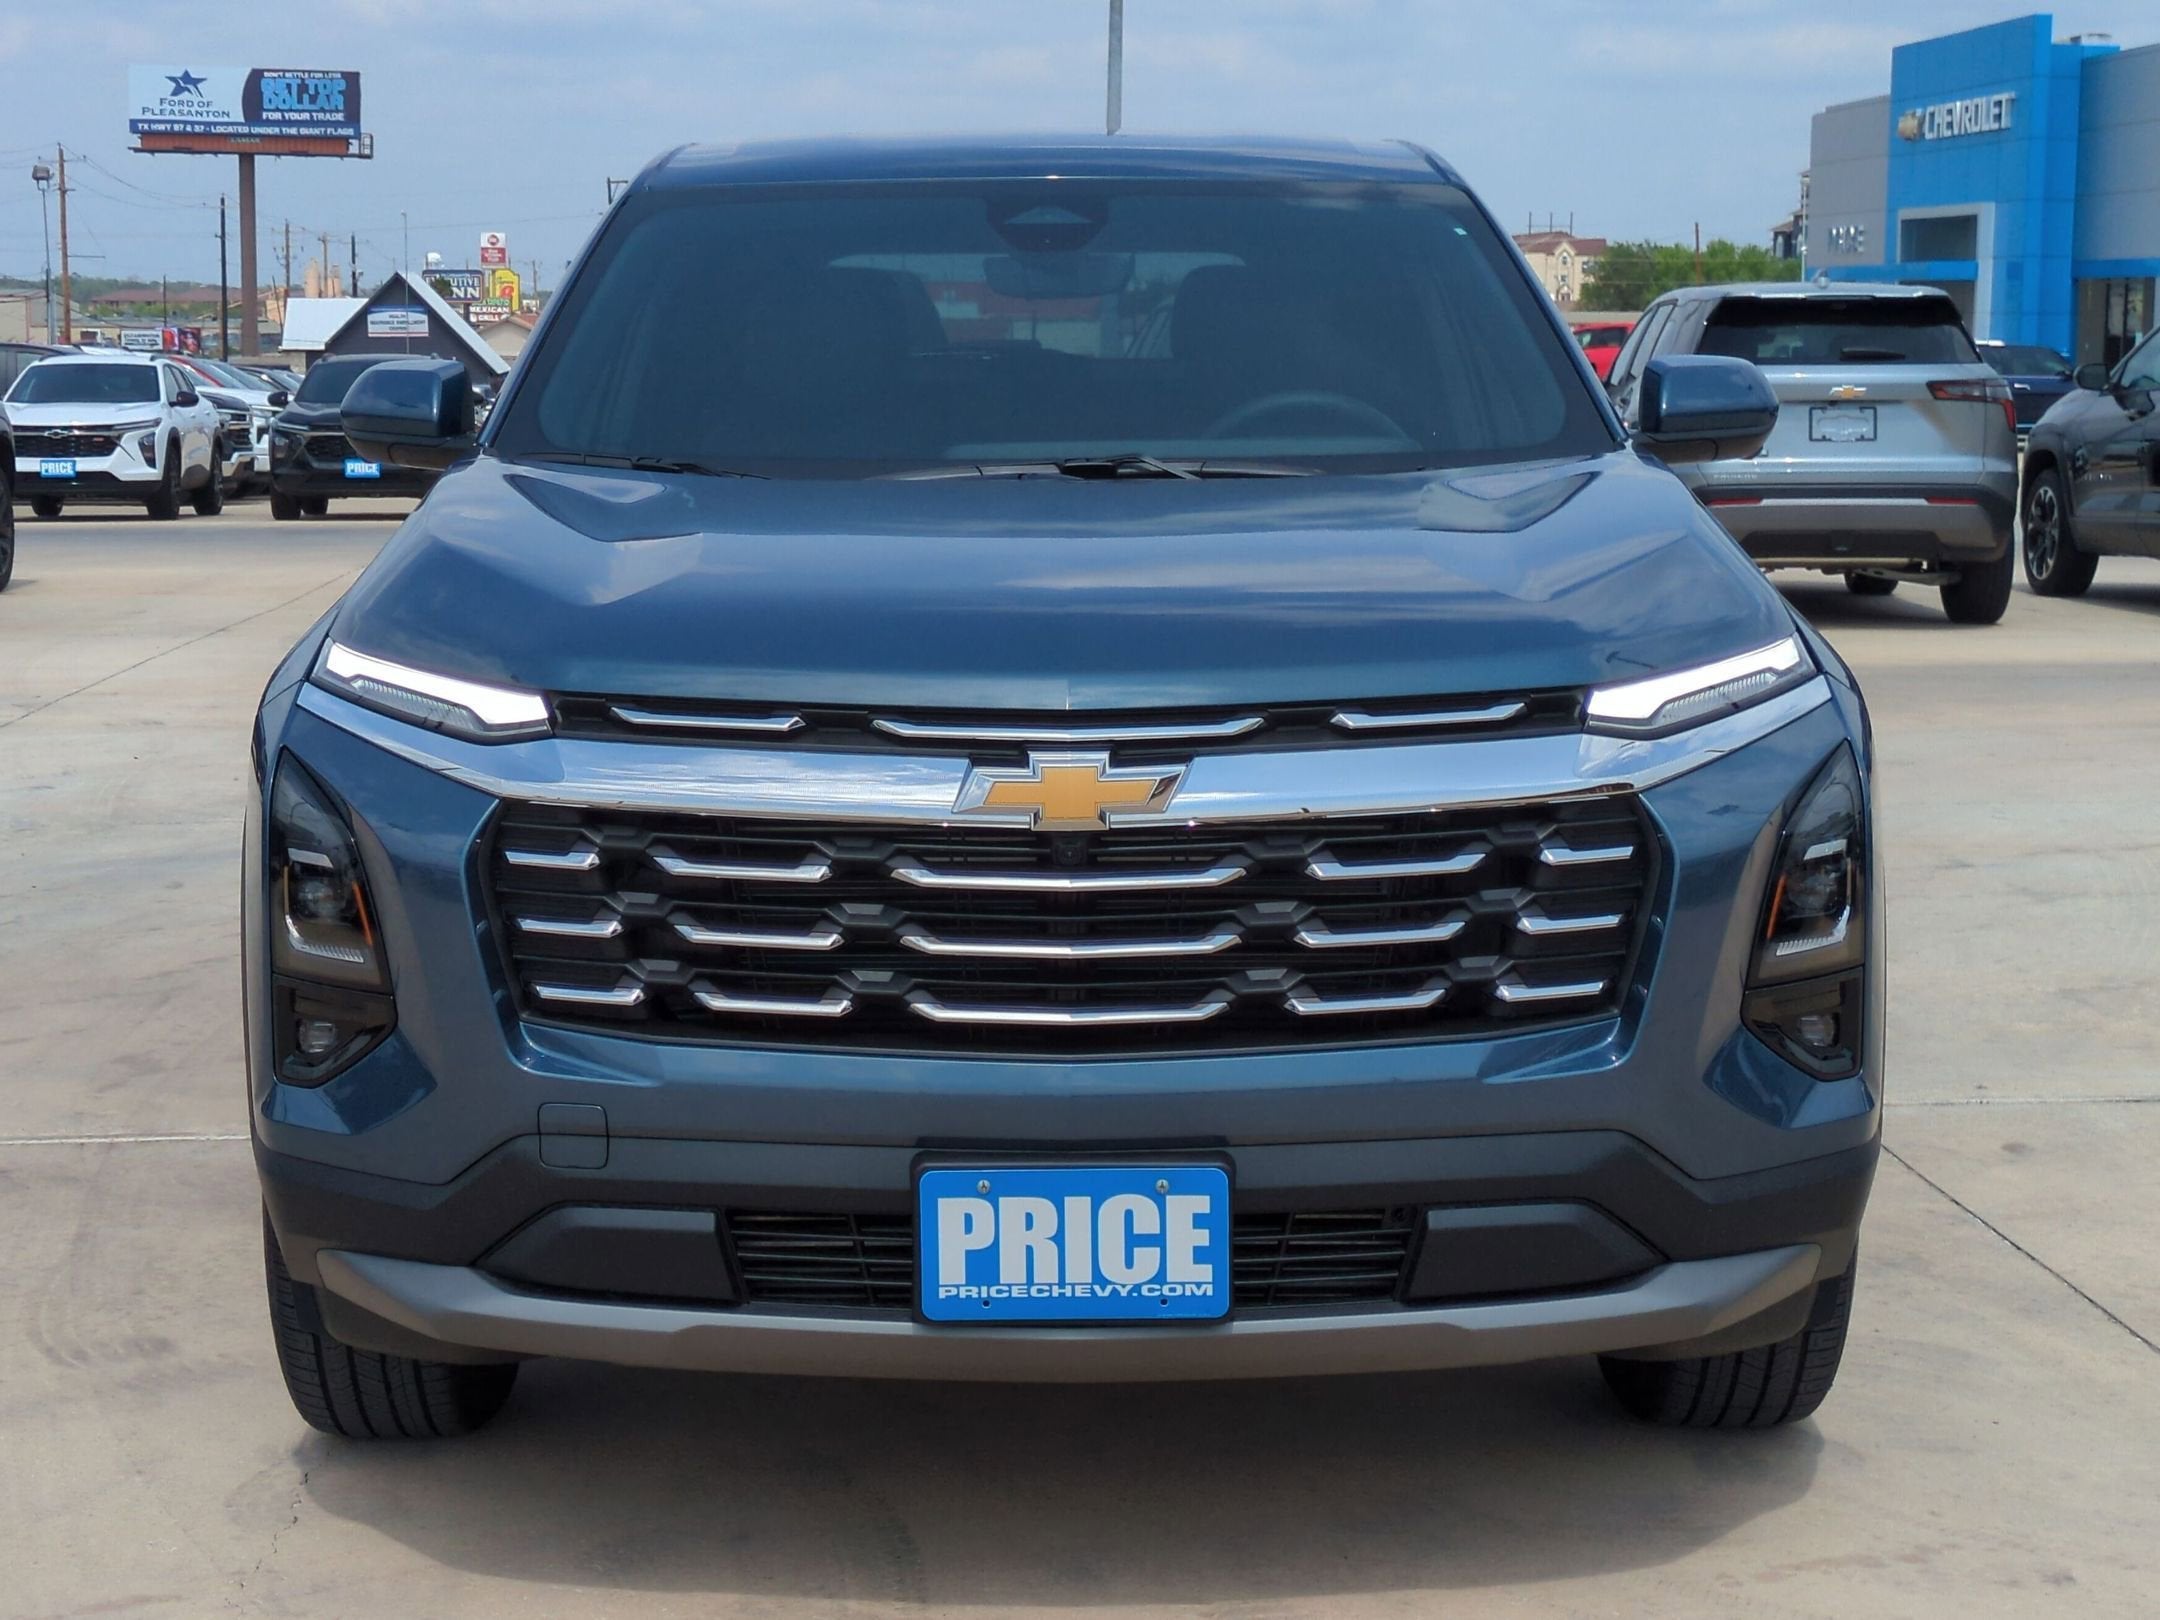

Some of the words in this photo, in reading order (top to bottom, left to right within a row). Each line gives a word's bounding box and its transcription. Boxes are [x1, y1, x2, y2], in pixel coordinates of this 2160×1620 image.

[261, 78, 302, 95] GET
[305, 79, 346, 95] TOP
[160, 98, 195, 108] FORD
[197, 100, 214, 108] OF
[263, 93, 344, 110] DOLLAR
[141, 106, 231, 119] PLEASANTON
[262, 111, 283, 120] FOR
[283, 112, 310, 120] YOUR
[312, 112, 345, 121] TRADE
[1924, 92, 2016, 140] CHEVROLET
[151, 123, 172, 131] HWY
[211, 125, 249, 133] LOCATED
[250, 126, 281, 134] UNDER
[281, 127, 298, 135] THE
[299, 127, 326, 135] GIANT
[327, 127, 354, 136] FLAGS
[469, 305, 510, 313] MEXICAN
[41, 462, 74, 475] PRICE
[346, 462, 380, 475] PRICE
[937, 1193, 1213, 1285] PRICE
[938, 1284, 1213, 1299] PRICECHEVY.COM
